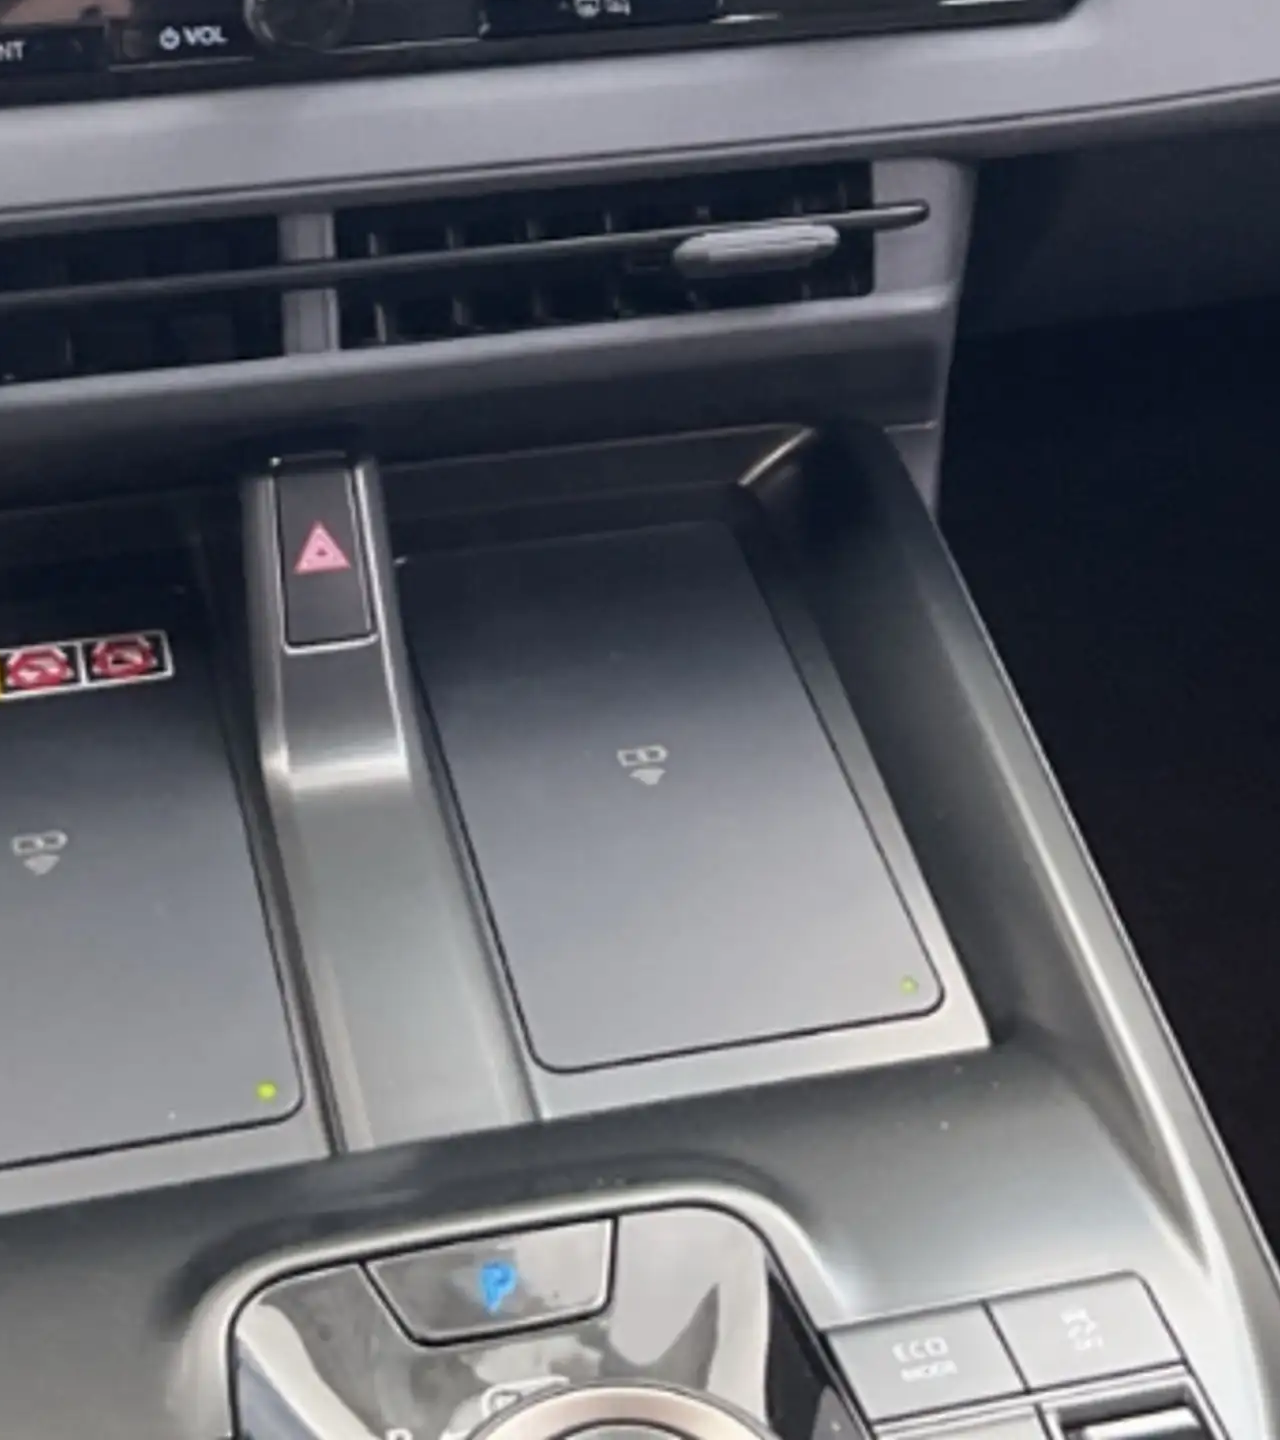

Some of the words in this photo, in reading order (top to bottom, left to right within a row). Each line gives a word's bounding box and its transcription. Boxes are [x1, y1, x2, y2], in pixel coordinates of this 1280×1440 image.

[183, 25, 228, 46] VOL
[480, 1261, 517, 1315] P
[891, 1335, 950, 1363] ECO
